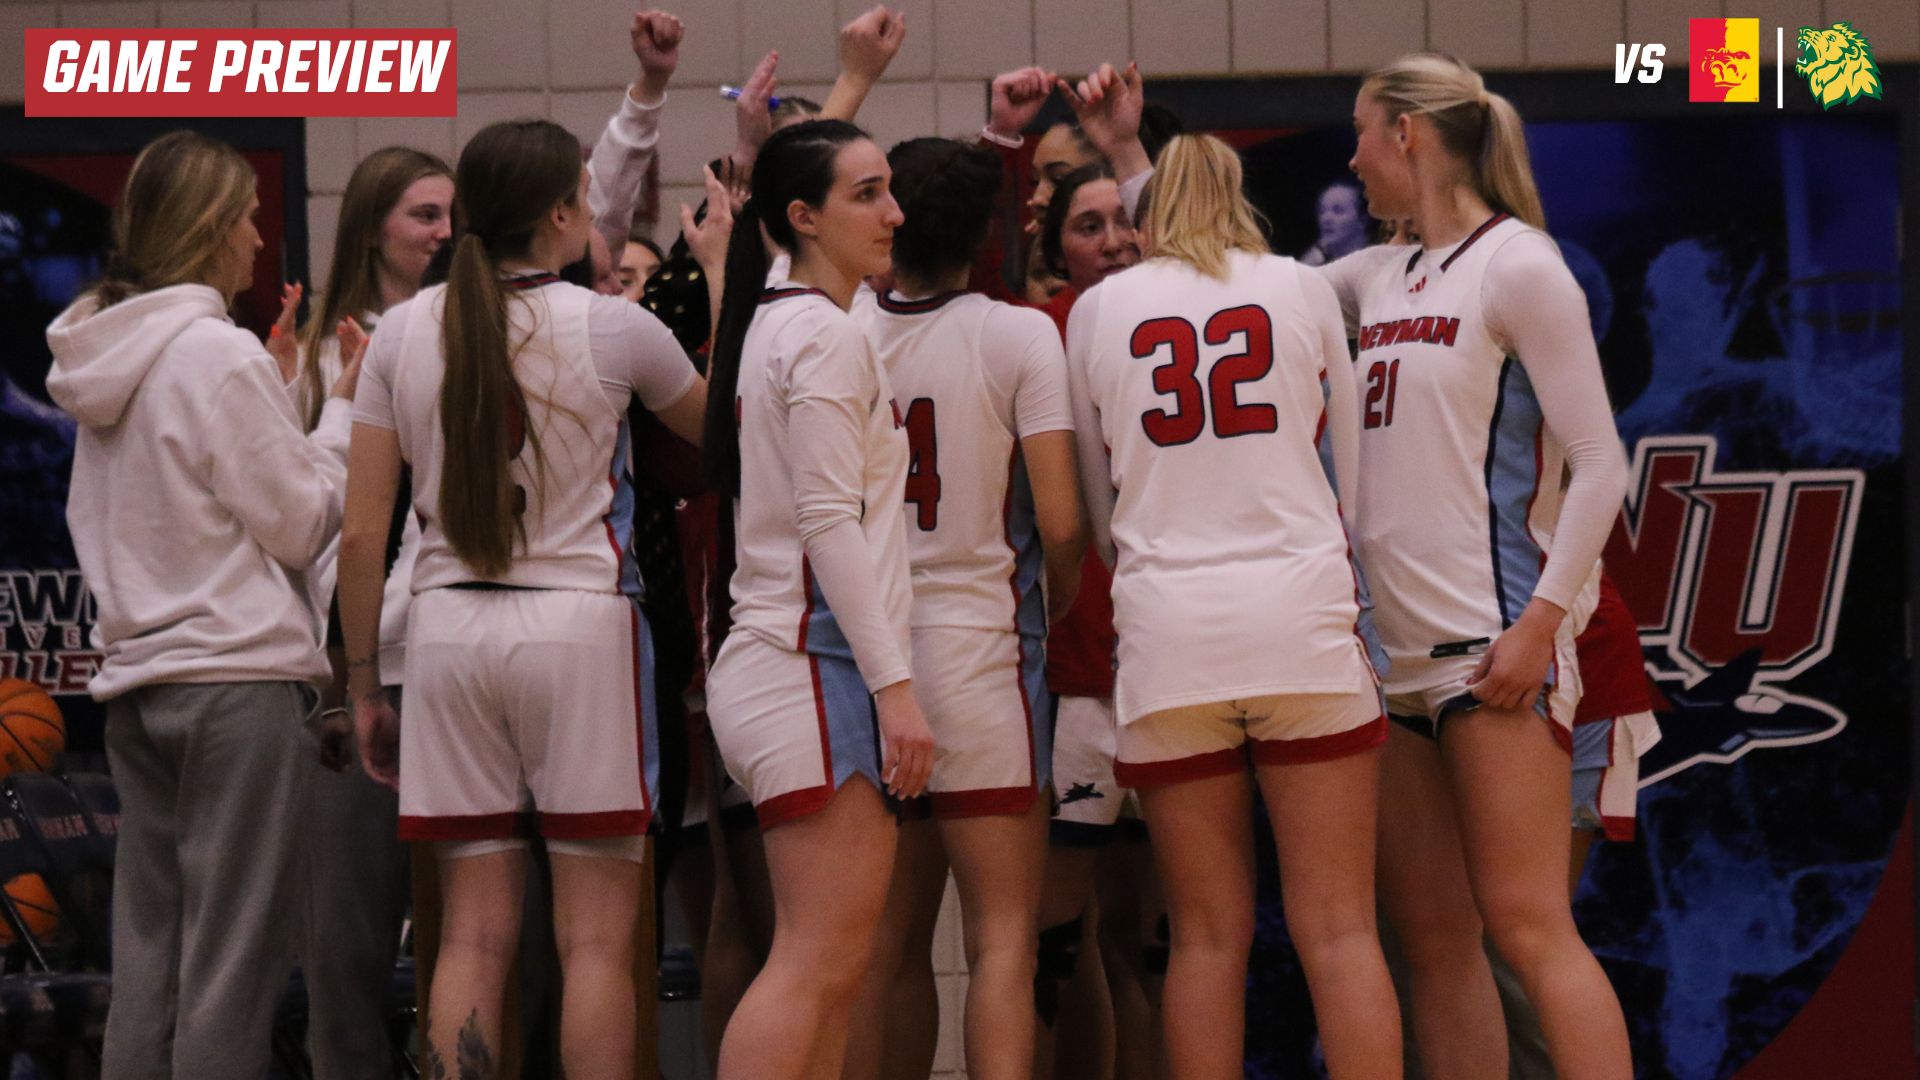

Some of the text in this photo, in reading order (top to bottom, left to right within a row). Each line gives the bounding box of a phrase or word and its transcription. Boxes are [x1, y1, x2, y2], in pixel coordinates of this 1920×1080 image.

[1130, 304, 1278, 447] 32
[1359, 316, 1460, 352] NEWMAN
[1363, 358, 1400, 430] 21
[902, 397, 941, 531] 4
[1600, 435, 1866, 681] NU
